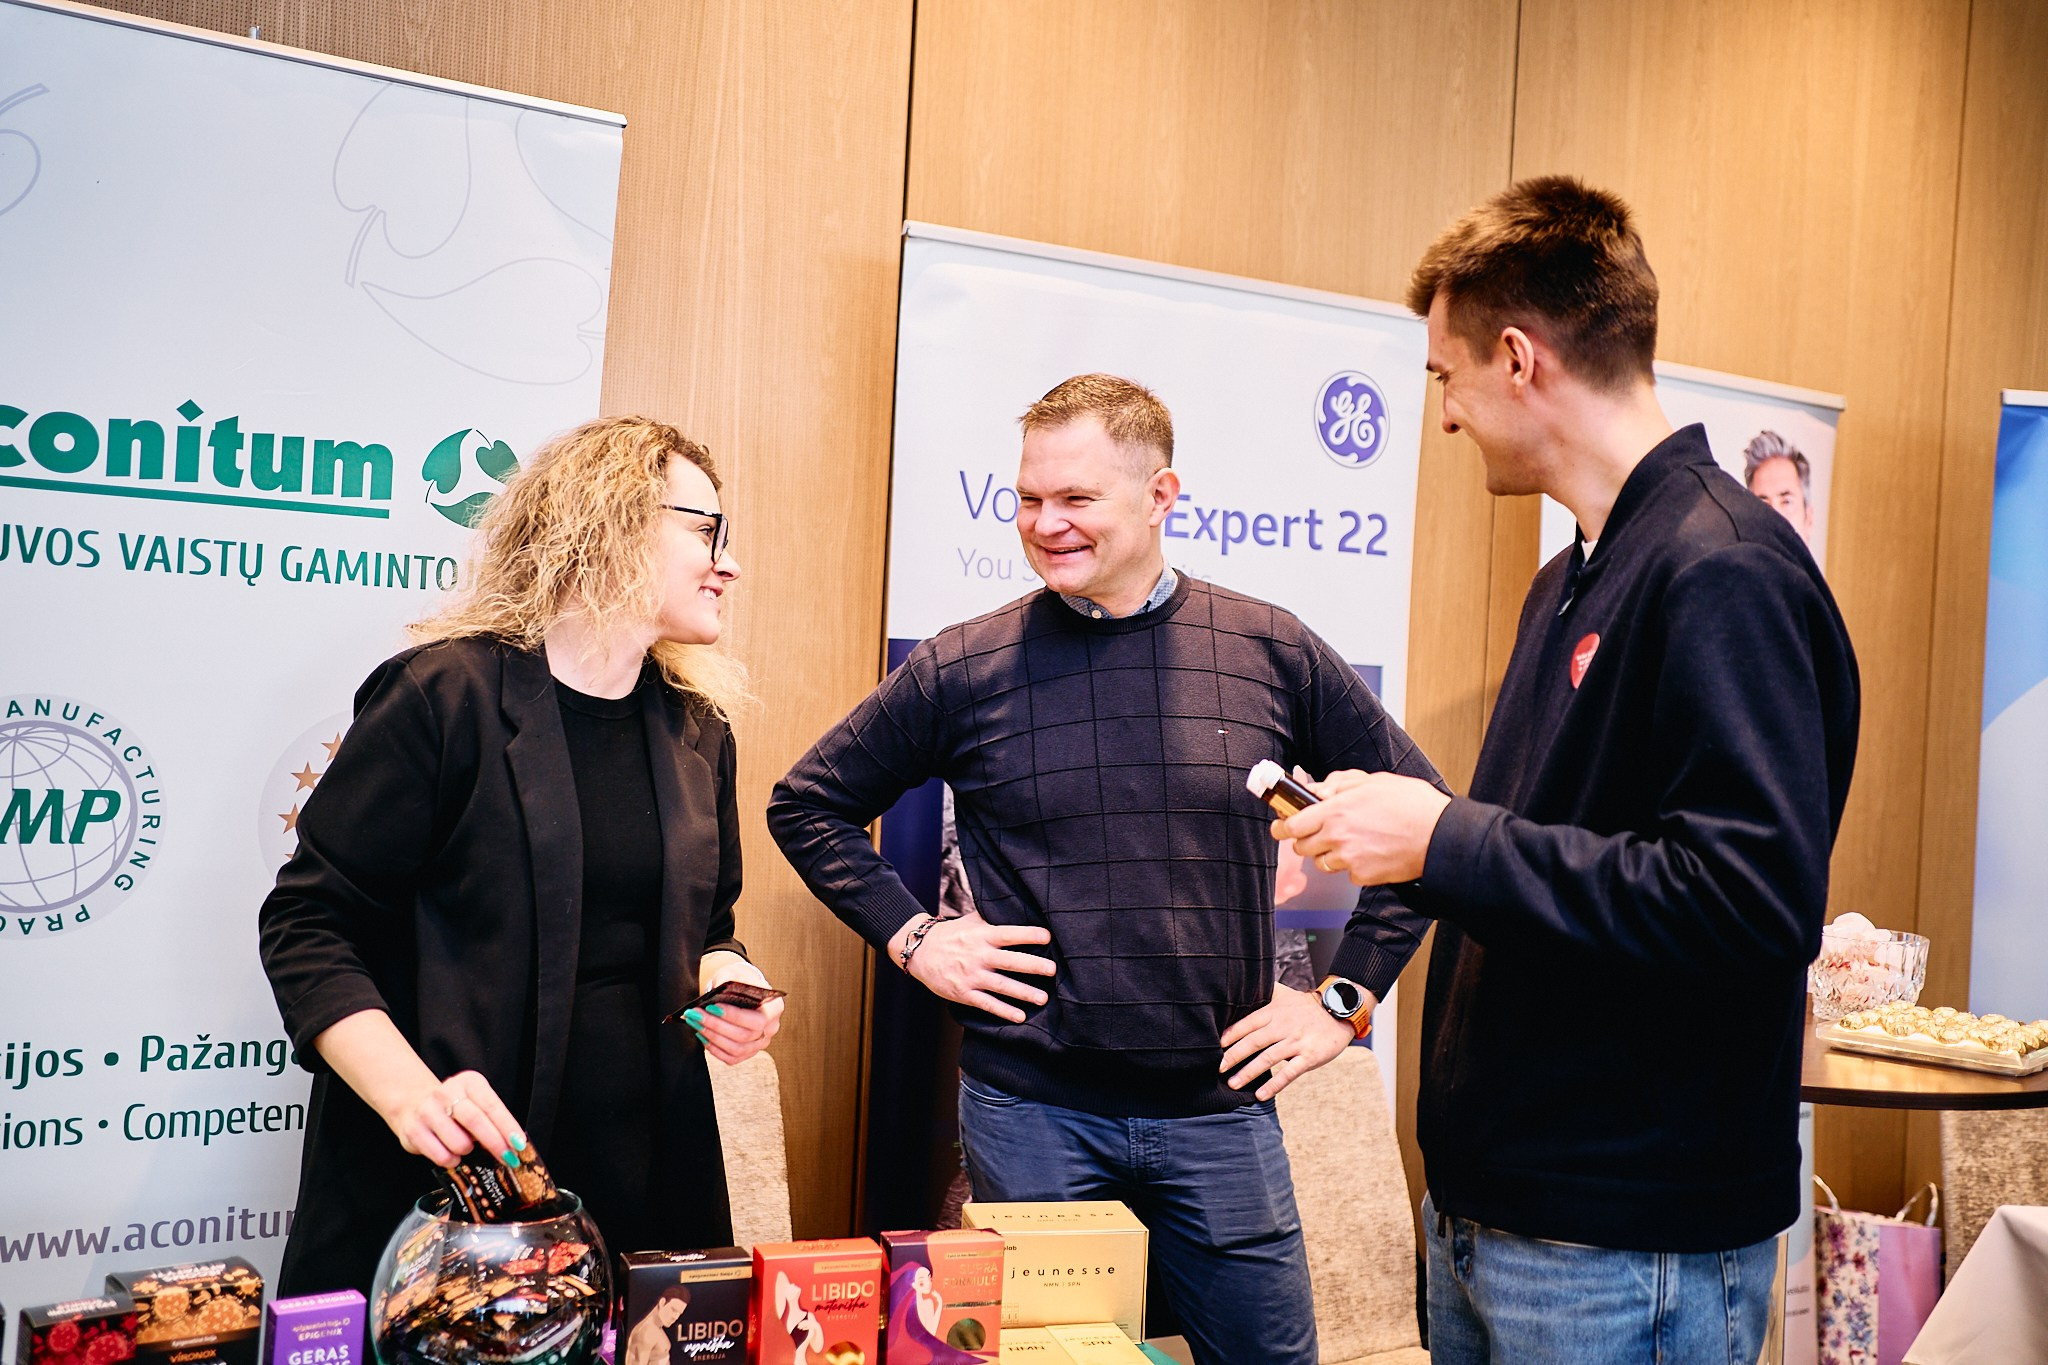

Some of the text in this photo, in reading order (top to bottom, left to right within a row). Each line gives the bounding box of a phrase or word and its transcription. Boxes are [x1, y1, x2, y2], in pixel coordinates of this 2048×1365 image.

[1165, 493, 1323, 556] Expert
[1337, 510, 1388, 556] 22
[118, 532, 264, 587] VAISTŲ
[957, 547, 1012, 580] You
[0, 1042, 84, 1090] ijos
[0, 1101, 304, 1149] ions Competen
[1011, 1265, 1115, 1279] jeunesse
[811, 1280, 875, 1301] LIBIDO
[677, 1319, 744, 1342] LIBIDO
[288, 1344, 349, 1365] GERAS
